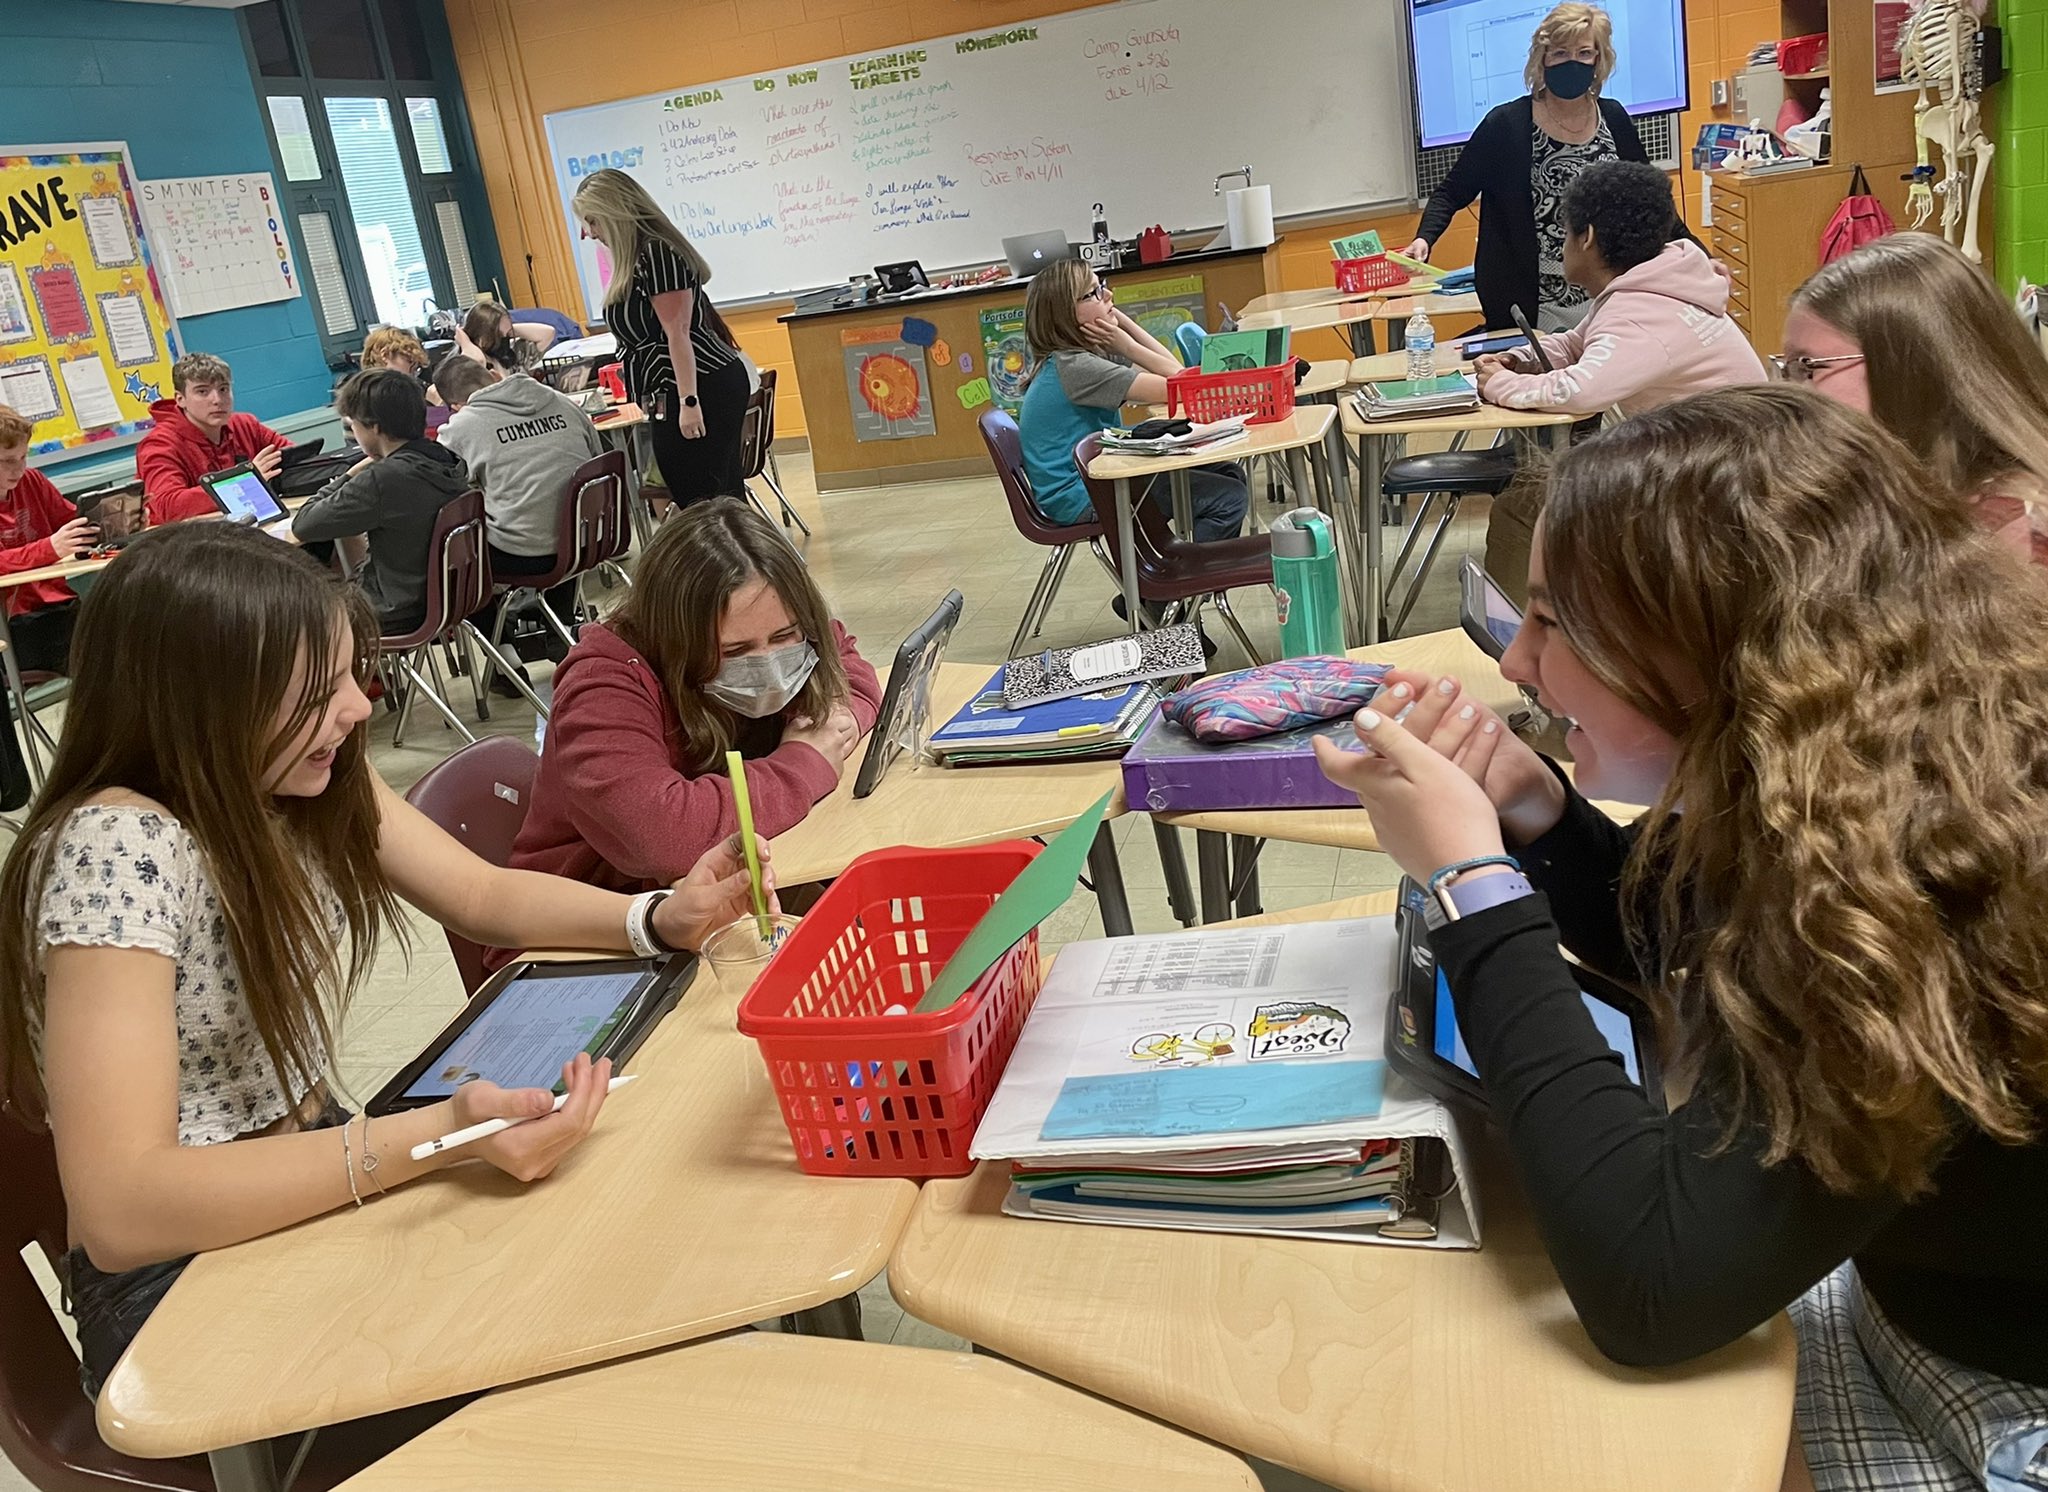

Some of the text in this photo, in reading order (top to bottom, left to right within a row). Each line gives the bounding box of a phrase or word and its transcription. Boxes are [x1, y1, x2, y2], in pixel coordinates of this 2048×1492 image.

[955, 26, 1038, 54] HOMEWORK
[1083, 38, 1120, 58] Camp
[849, 49, 927, 76] LEARNING
[1096, 65, 1132, 79] Forms
[753, 69, 818, 92] DO NOW
[849, 66, 921, 90] TARGETS
[1136, 73, 1174, 96] 4/12
[664, 89, 723, 112] AGENDA
[567, 145, 644, 177] BIOLOGY
[1037, 163, 1063, 182] 4/11
[143, 178, 247, 201] S M T W T F S
[879, 182, 899, 196] will
[985, 313, 1006, 322] Parts
[963, 381, 988, 405] Cell
[496, 414, 568, 444] CUMMINGS
[1257, 1027, 1338, 1056] West
